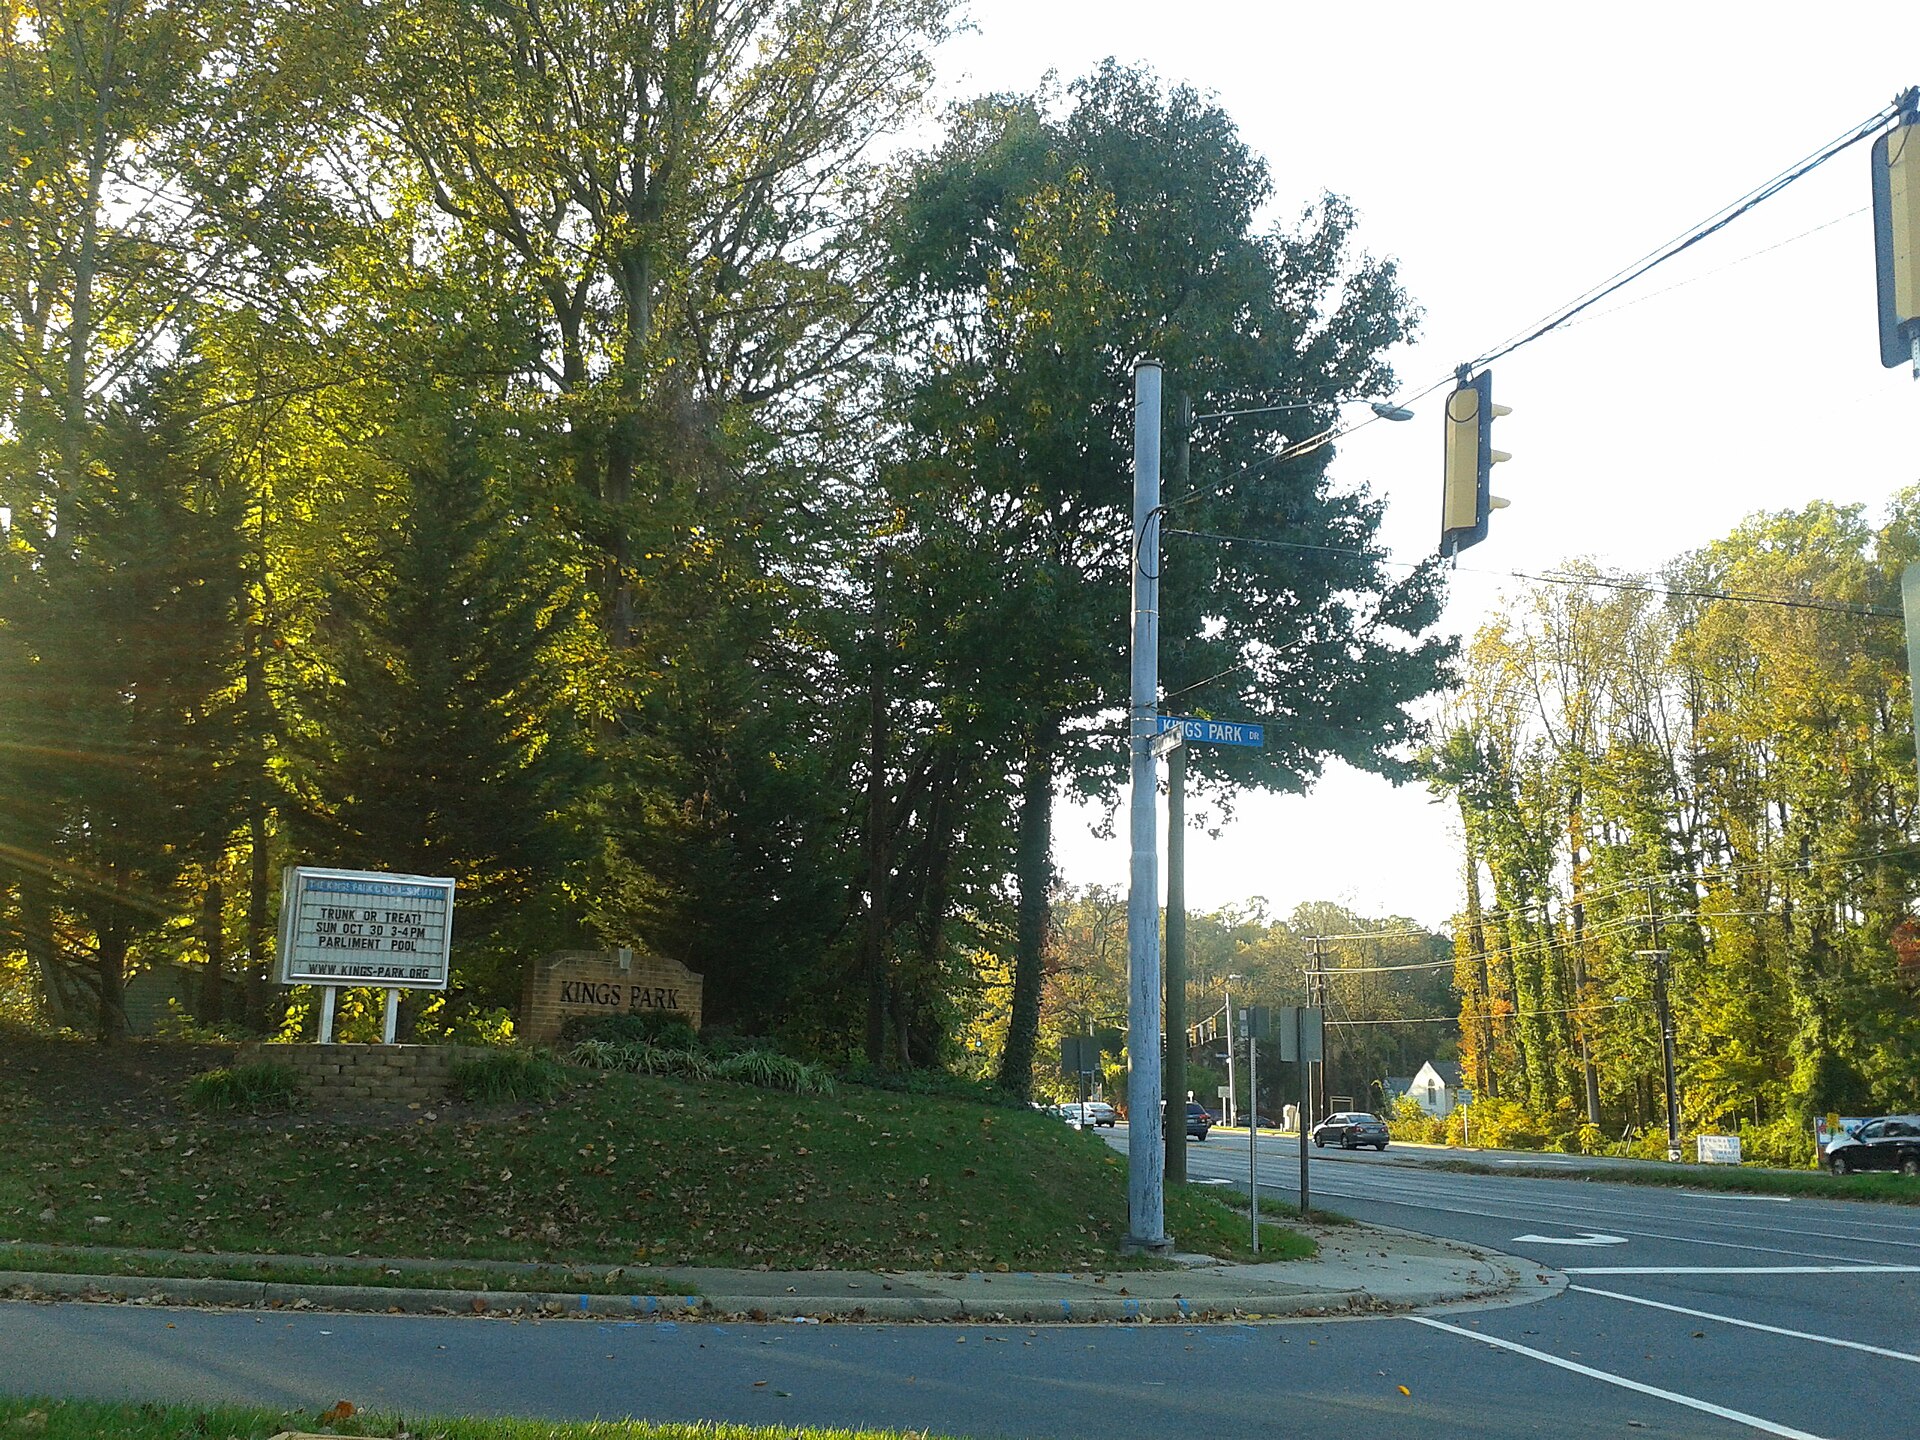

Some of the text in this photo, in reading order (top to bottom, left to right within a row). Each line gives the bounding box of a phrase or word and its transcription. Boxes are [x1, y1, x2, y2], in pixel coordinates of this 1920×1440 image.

[1209, 724, 1242, 742] PARK
[1249, 731, 1260, 740] DR
[321, 908, 422, 925] TRUNK OR TREAT!
[316, 922, 337, 933] SUN
[343, 923, 364, 935] OCT
[370, 925, 384, 936] 30
[319, 936, 417, 951] PARLIMENT POOL
[309, 964, 430, 979] WWW.KINGS-PARK.ORG
[560, 980, 680, 1009] KINGS PARK
